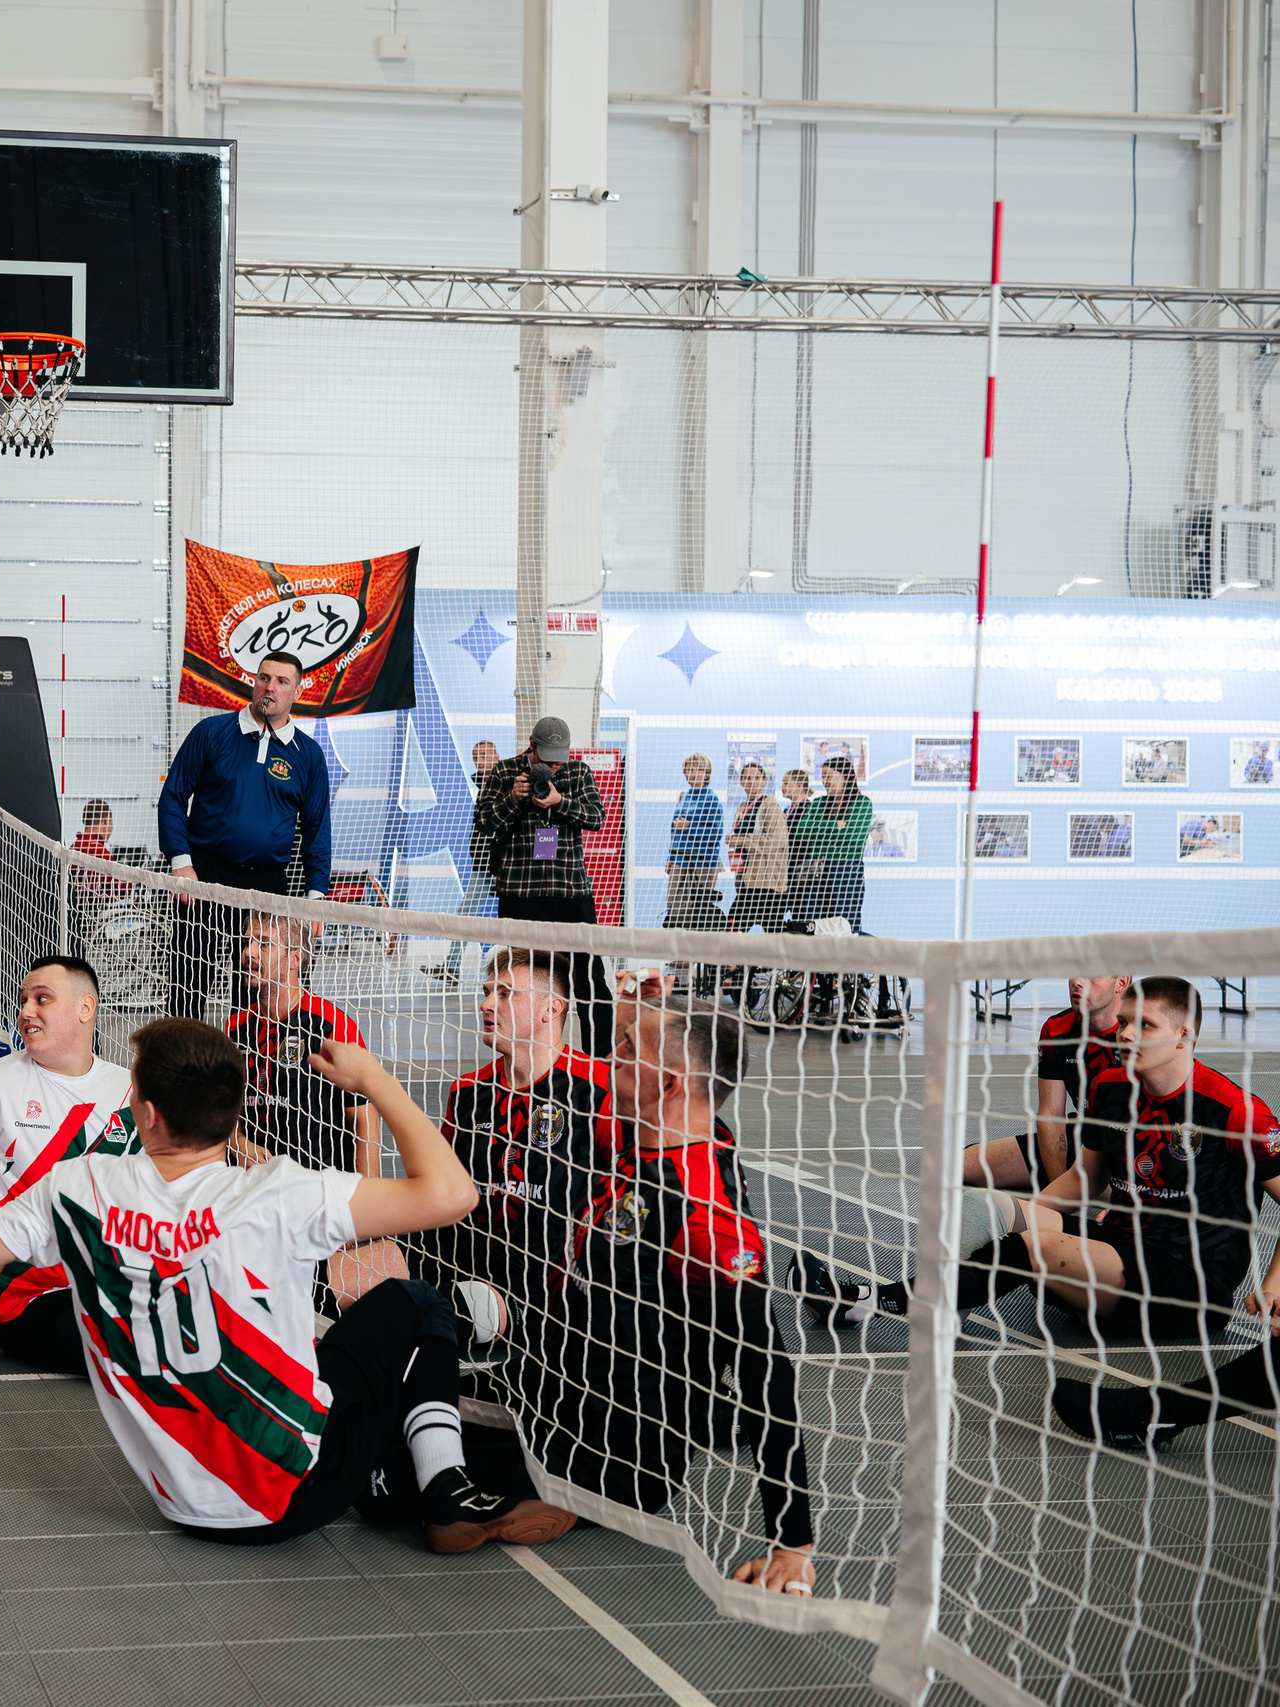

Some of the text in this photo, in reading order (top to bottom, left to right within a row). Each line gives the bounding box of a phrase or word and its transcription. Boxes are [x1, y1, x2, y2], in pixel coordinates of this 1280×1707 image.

[220, 577, 338, 659] БАСКЕТБОЛ НА КОЛЕСАХ
[562, 613, 579, 631] ПК
[334, 629, 373, 673] ИЖЕВСК
[102, 1205, 222, 1258] МОСКВА
[119, 1264, 222, 1377] 10
